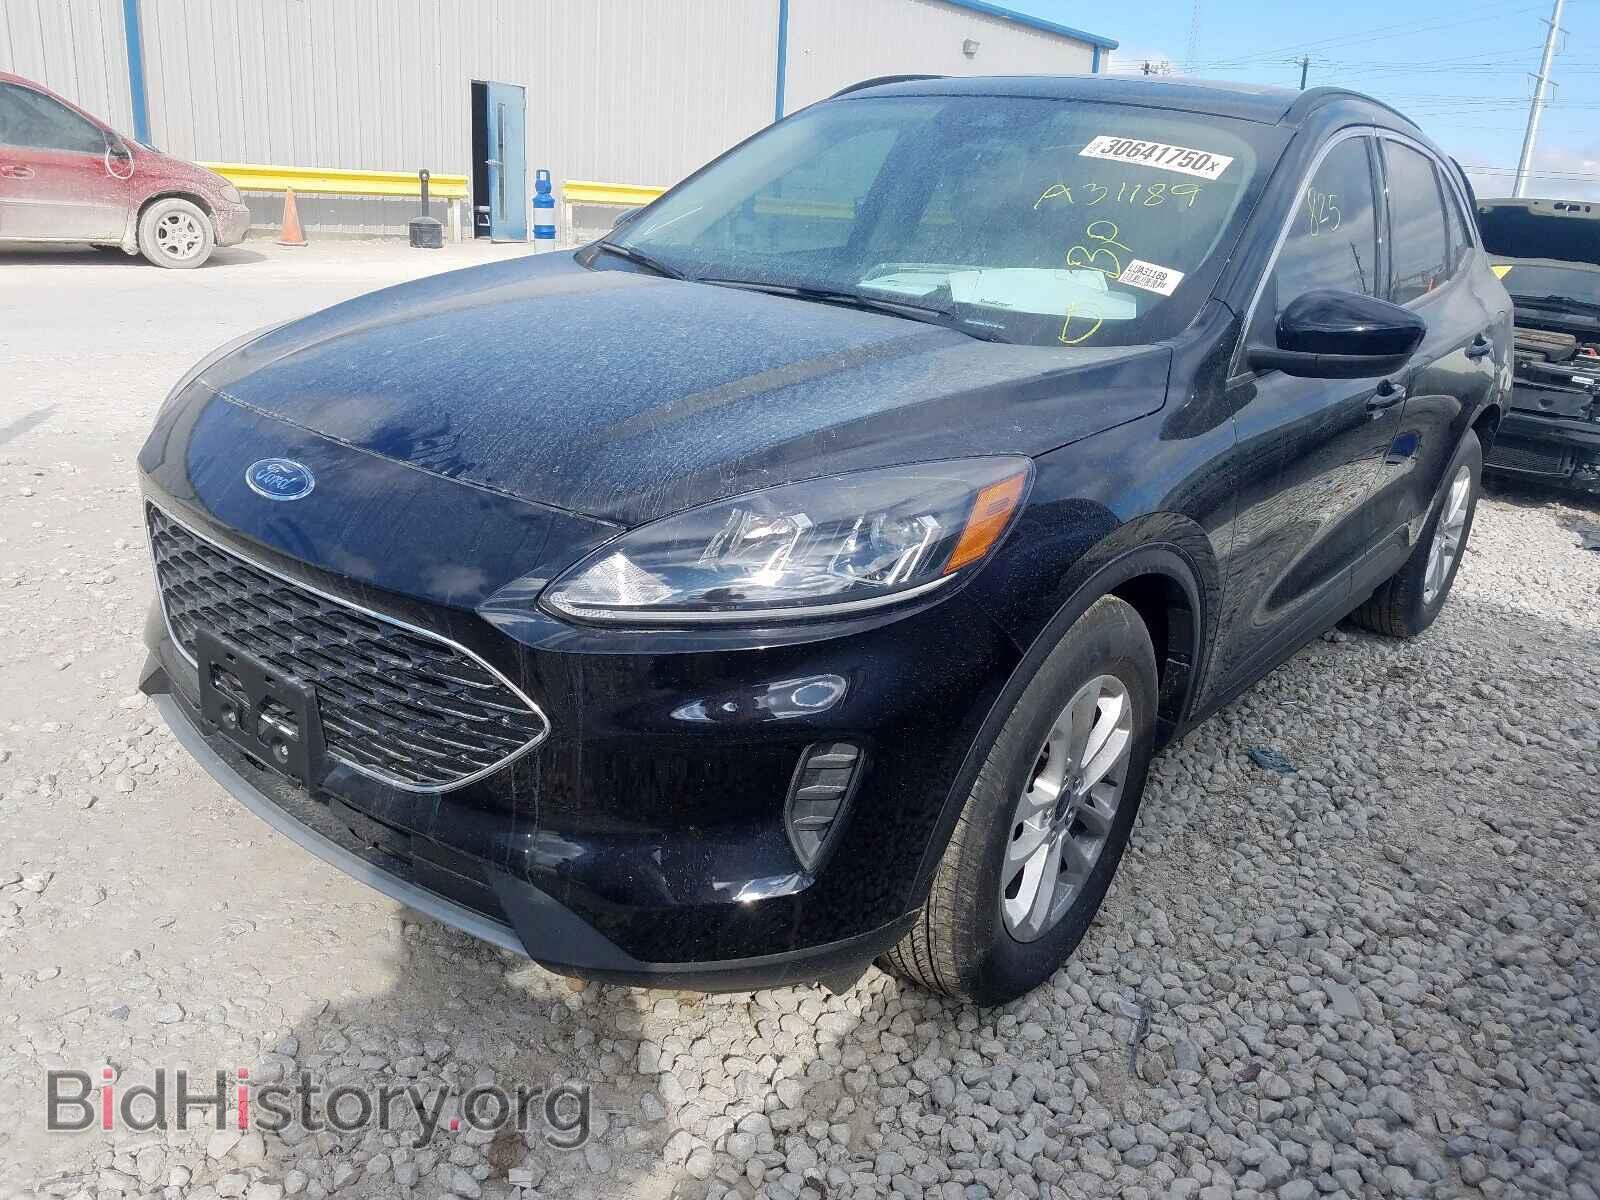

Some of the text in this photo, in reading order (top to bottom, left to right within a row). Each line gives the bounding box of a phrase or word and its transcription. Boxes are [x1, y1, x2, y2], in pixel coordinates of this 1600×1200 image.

[1032, 181, 1203, 210] A31189
[1306, 187, 1342, 238] 825
[255, 463, 299, 490] Ford
